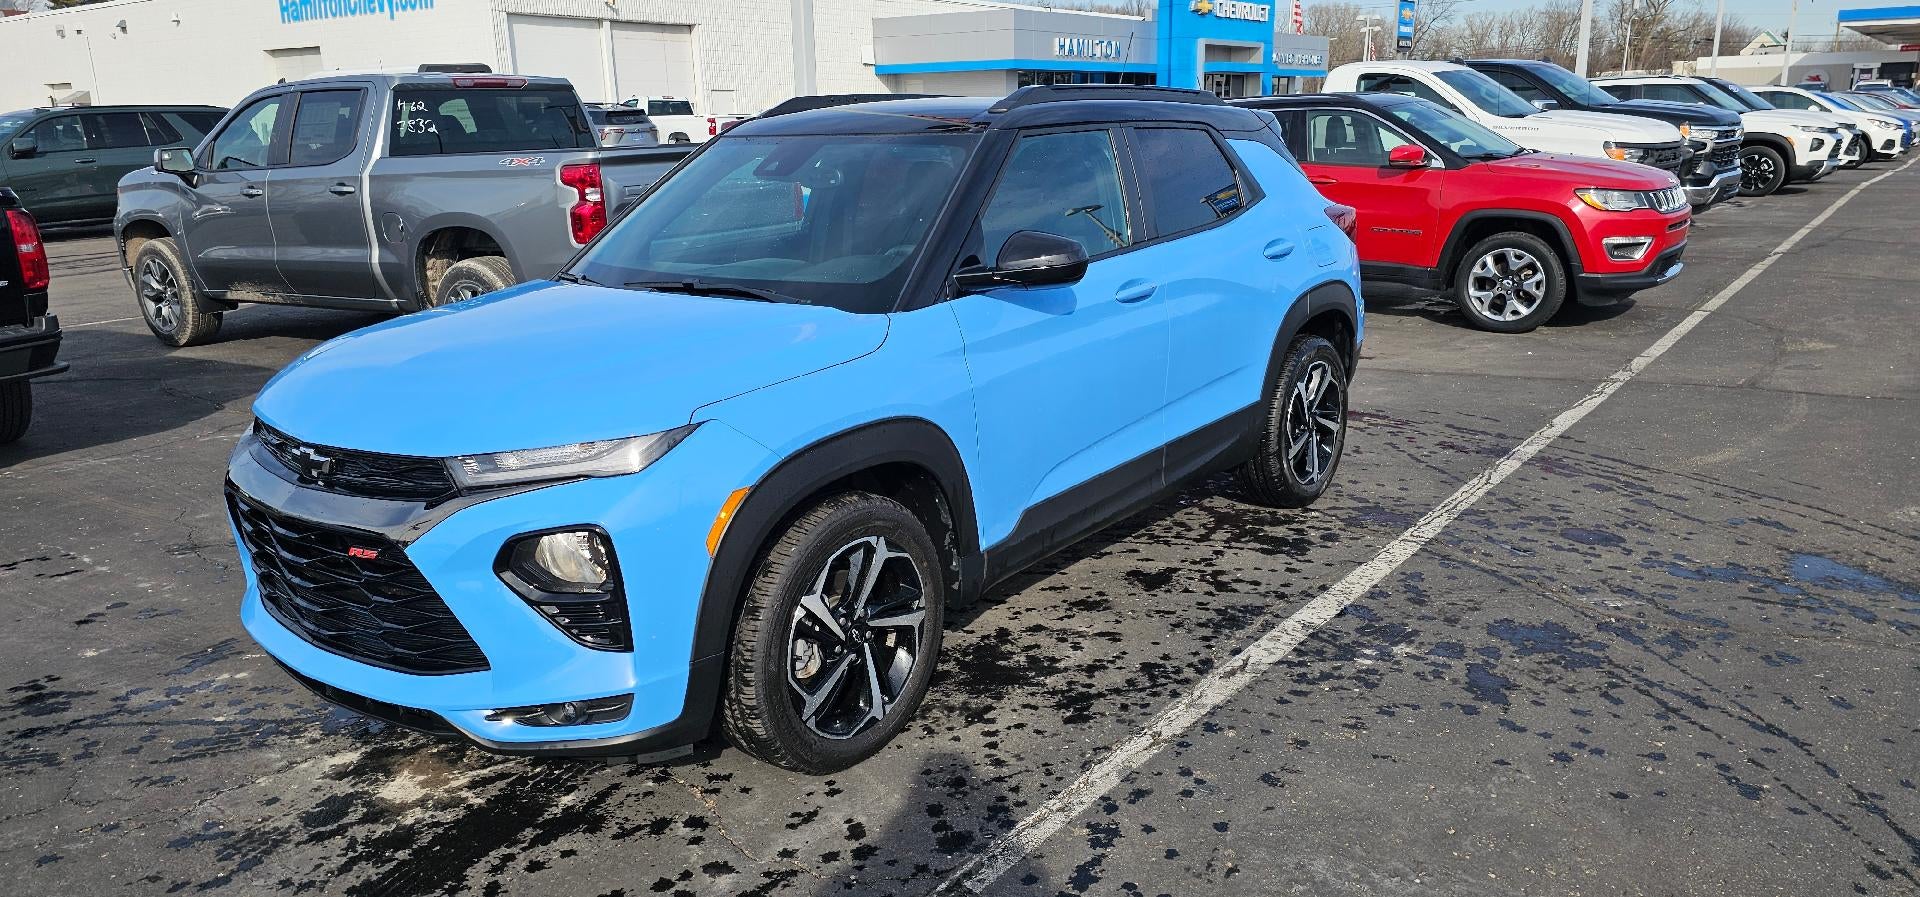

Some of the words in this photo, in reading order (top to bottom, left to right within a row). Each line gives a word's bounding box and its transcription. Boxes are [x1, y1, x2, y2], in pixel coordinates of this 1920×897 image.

[1216, 0, 1270, 22] CHEVROLET
[1055, 37, 1121, 59] HAMILTON
[349, 547, 378, 559] RS
